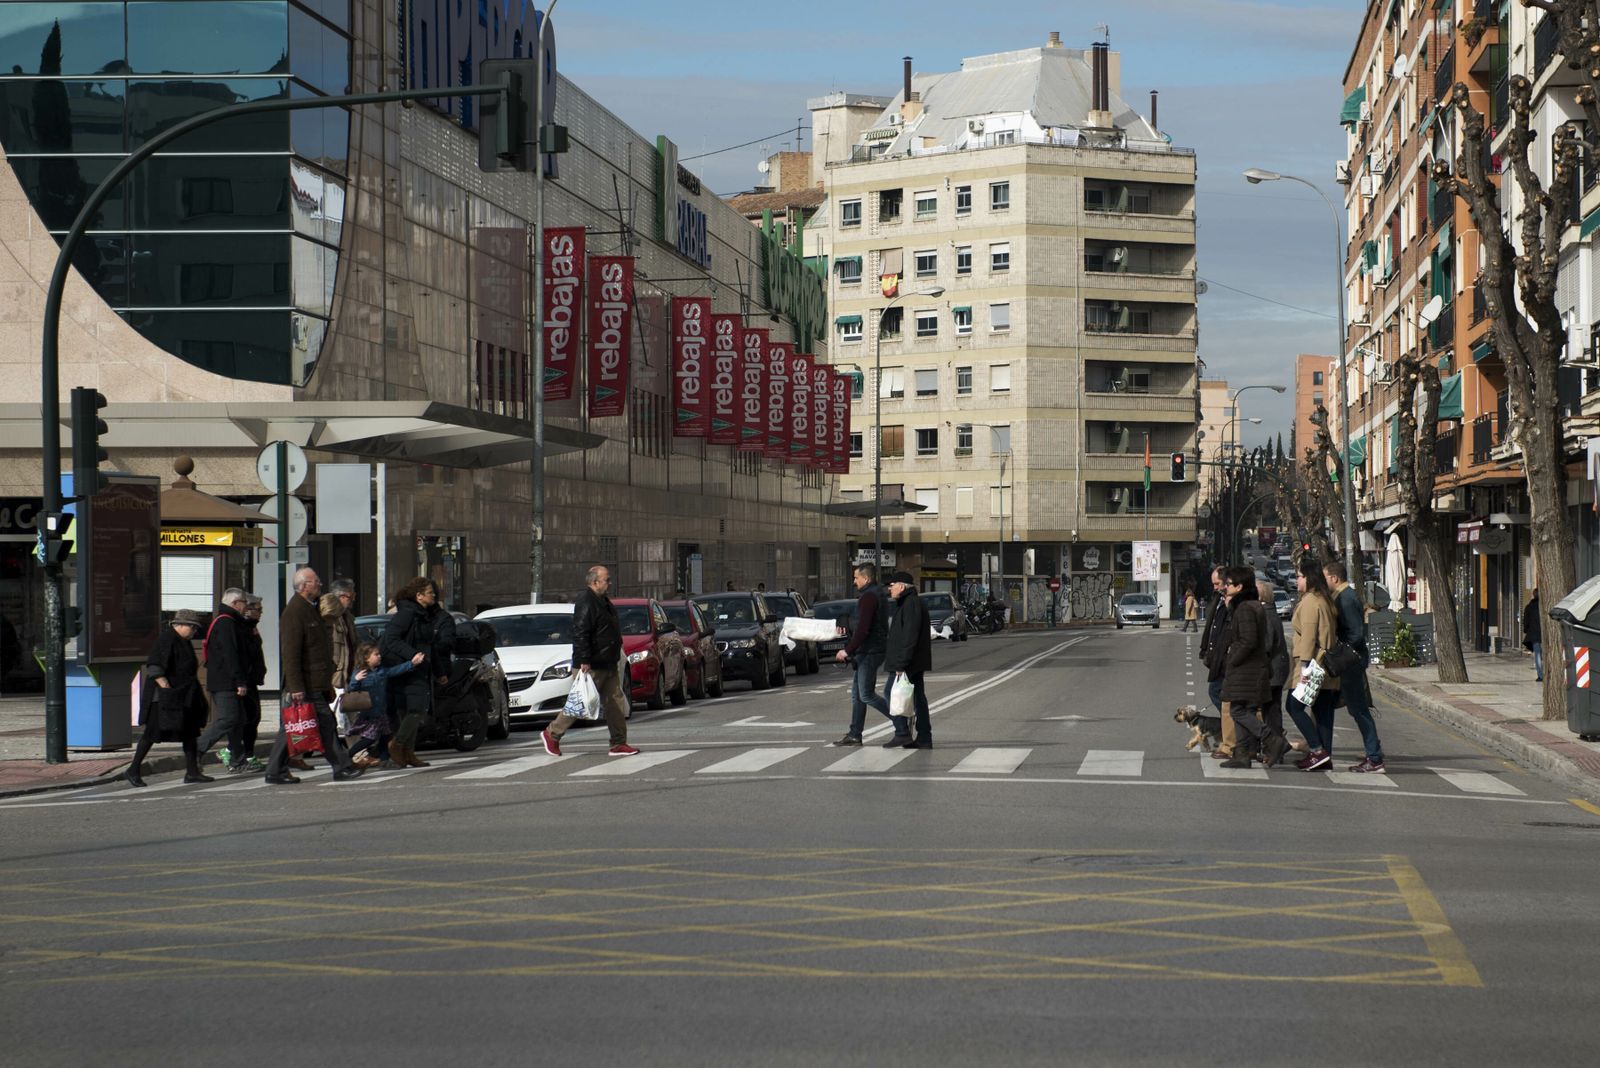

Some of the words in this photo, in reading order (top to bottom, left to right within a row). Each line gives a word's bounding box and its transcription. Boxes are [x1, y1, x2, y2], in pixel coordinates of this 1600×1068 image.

[544, 234, 579, 361] rebajas
[594, 263, 628, 381] rebajas
[676, 303, 706, 405] rebajas
[710, 319, 737, 415] rebajas
[741, 333, 765, 423] rebajas
[768, 348, 788, 432] rebajas
[791, 359, 811, 439] rebajas
[813, 369, 831, 445] rebajas
